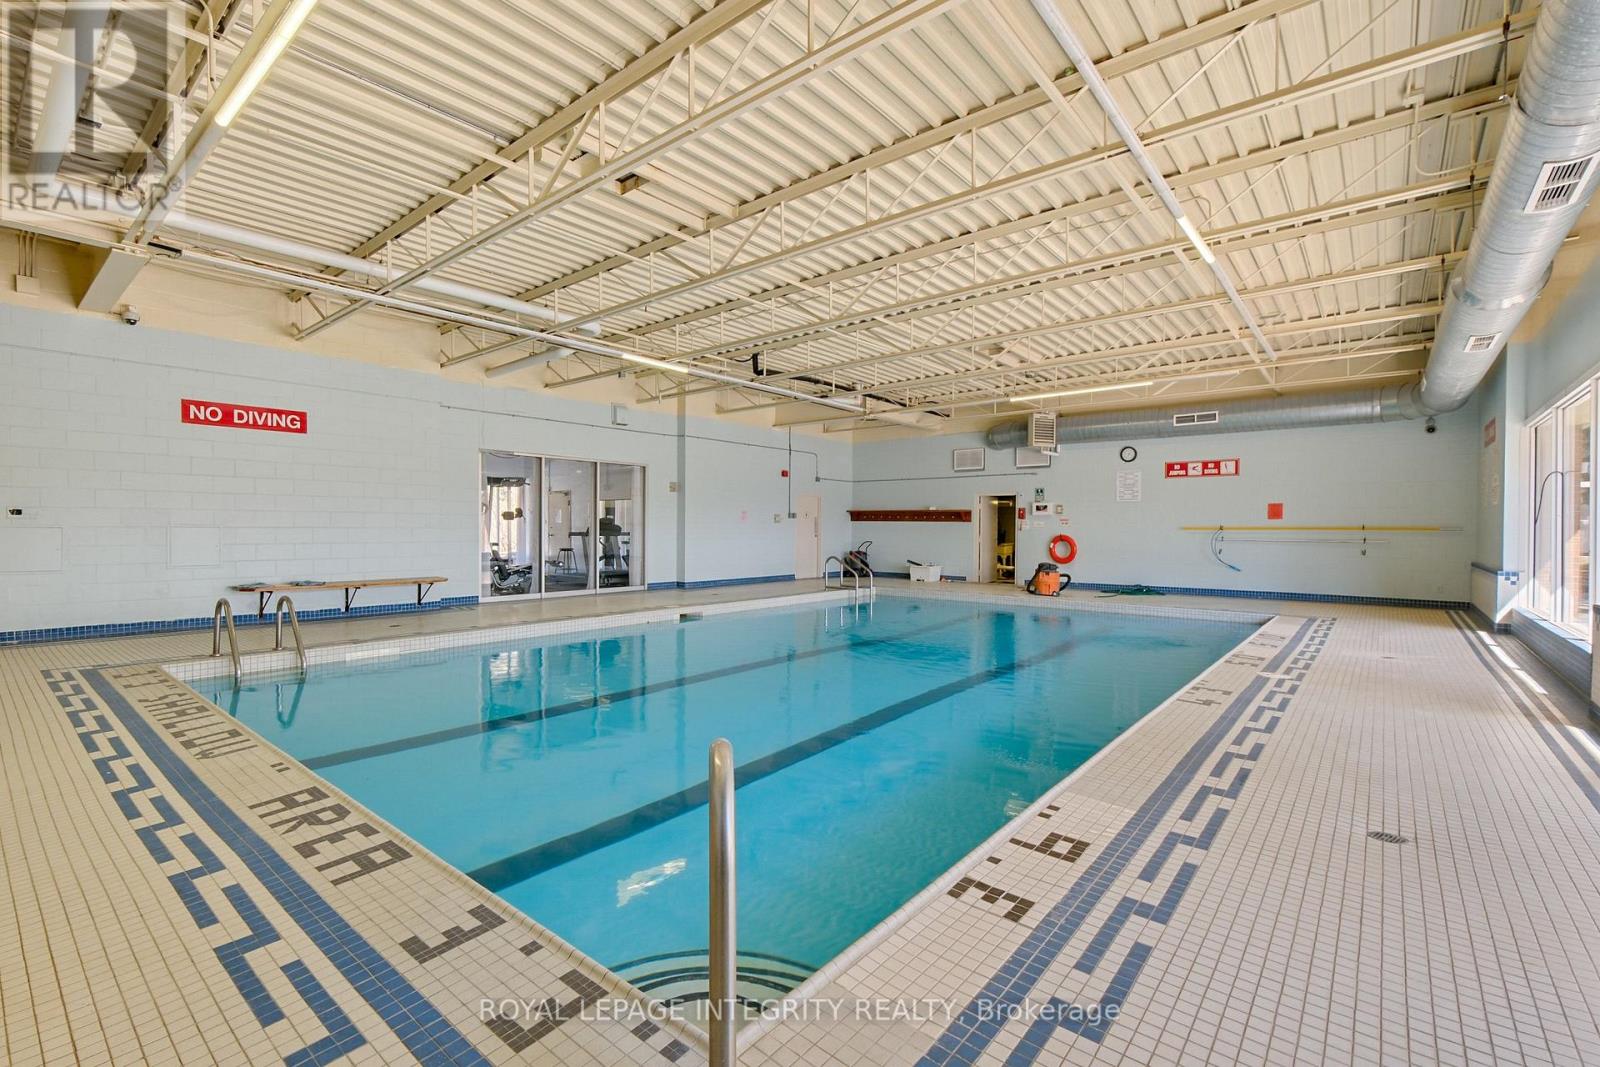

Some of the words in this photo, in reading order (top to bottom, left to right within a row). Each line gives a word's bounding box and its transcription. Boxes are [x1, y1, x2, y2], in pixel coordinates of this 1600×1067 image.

[189, 404, 223, 422] NO
[233, 409, 301, 429] DIVING
[248, 785, 413, 886] AREA
